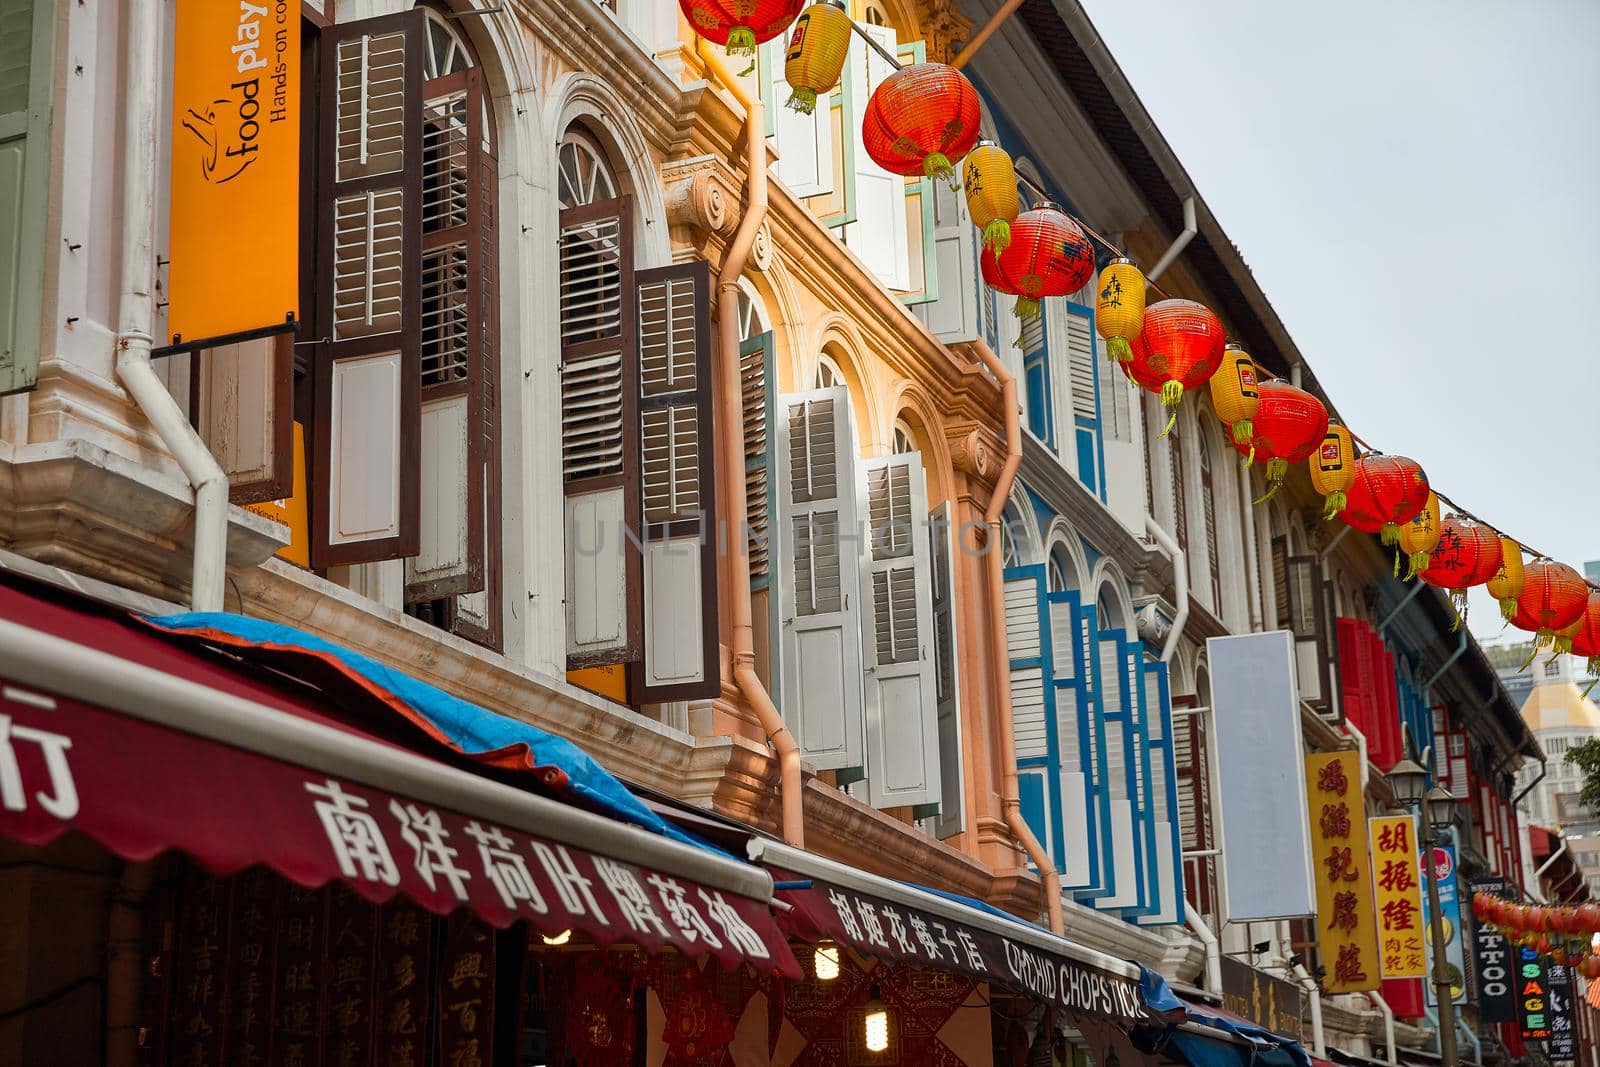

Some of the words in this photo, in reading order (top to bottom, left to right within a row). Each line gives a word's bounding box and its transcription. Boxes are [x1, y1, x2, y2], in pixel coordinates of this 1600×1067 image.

[231, 0, 268, 73] play
[276, 0, 288, 24] co
[226, 77, 260, 157] food
[270, 29, 288, 123] Hands-on
[0, 687, 80, 819] 行
[304, 780, 771, 959] 南洋荷叶牌药油
[1377, 821, 1419, 932] 胡振隆
[828, 888, 988, 972] 胡姬花筷子店
